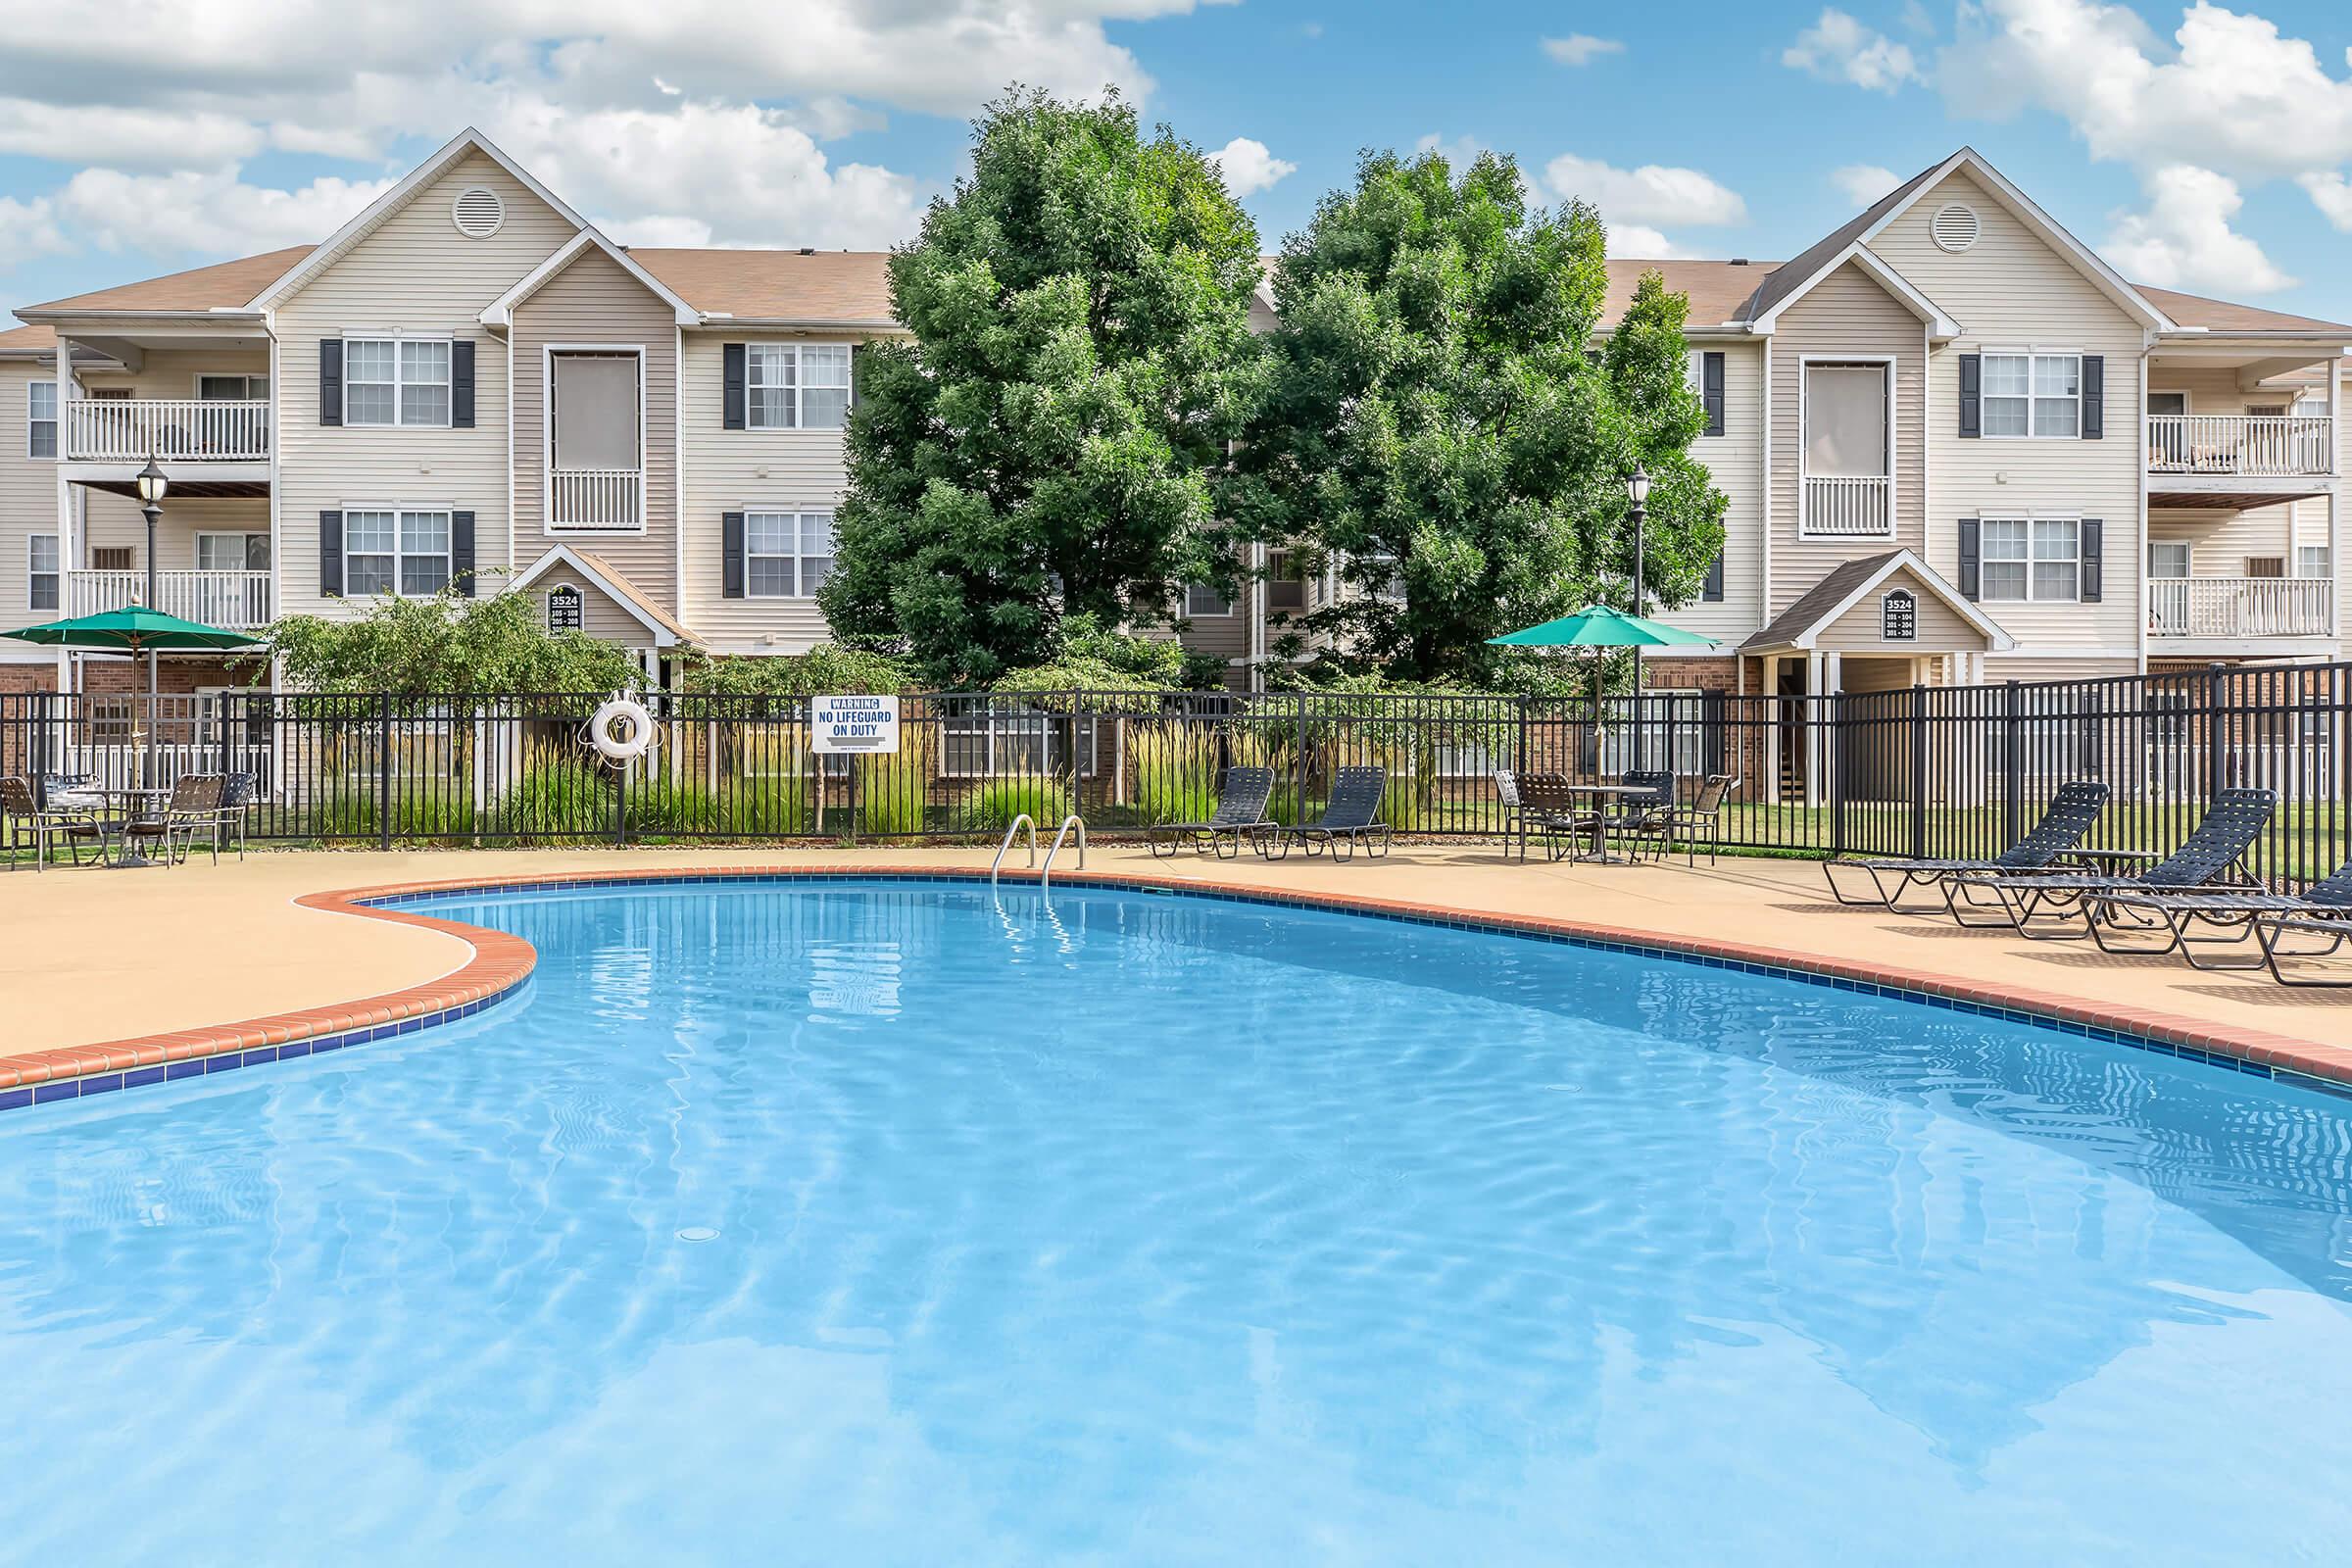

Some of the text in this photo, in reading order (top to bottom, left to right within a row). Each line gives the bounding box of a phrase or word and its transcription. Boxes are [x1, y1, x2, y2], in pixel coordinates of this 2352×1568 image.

[552, 596, 578, 606] 3524
[1886, 600, 1912, 610] 3524
[831, 699, 879, 710] WARNING
[818, 711, 892, 722] NO LIFEGUARD
[833, 725, 878, 736] ON DUTY
